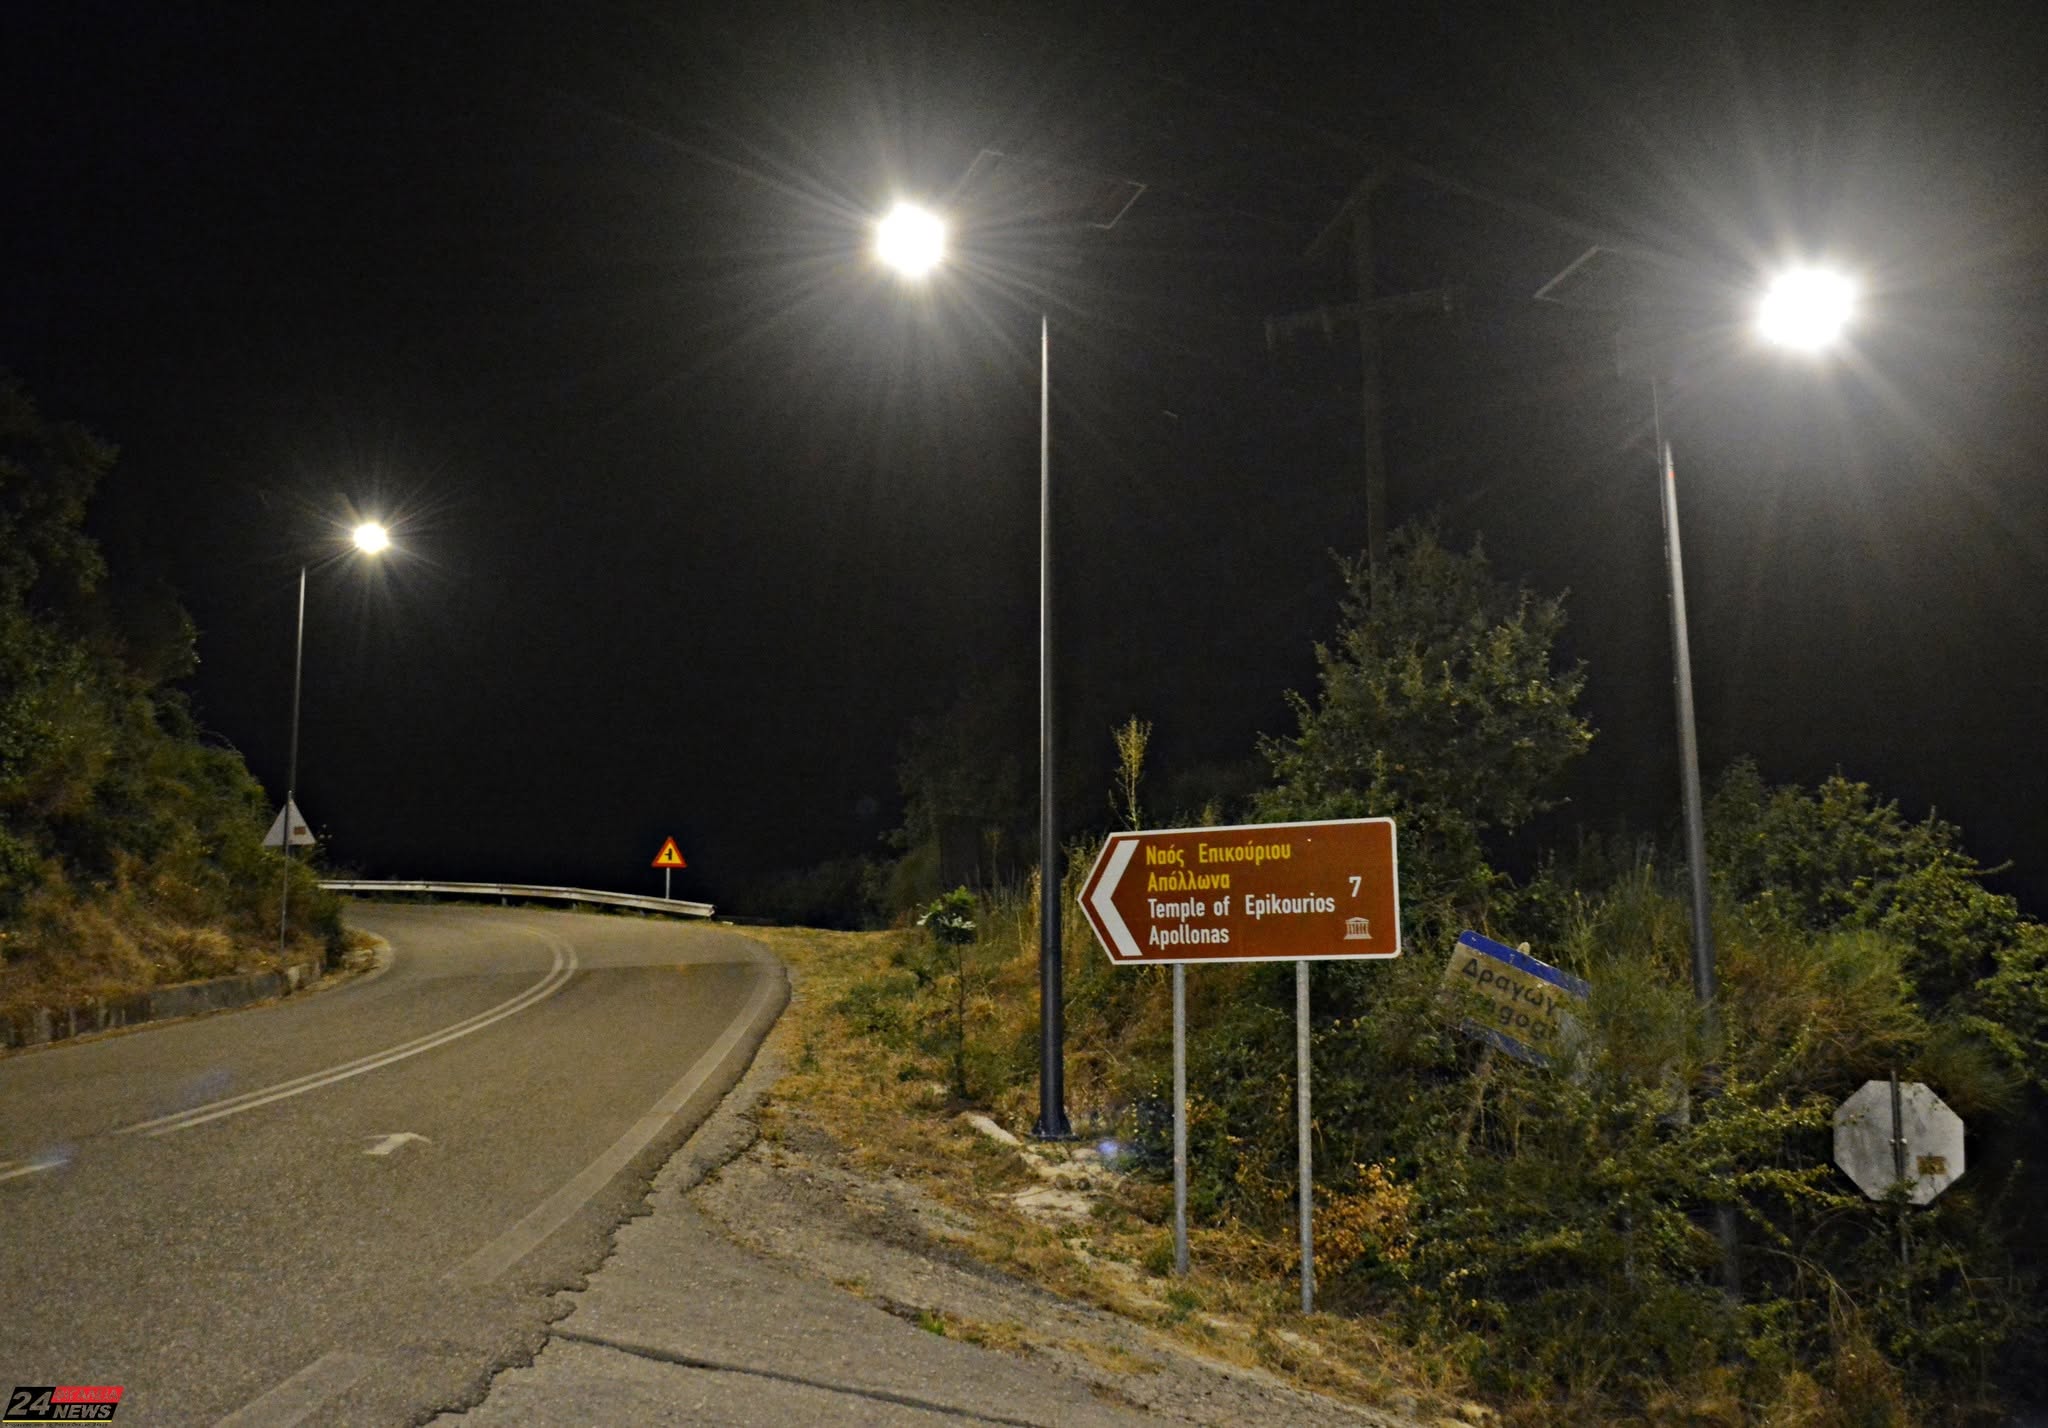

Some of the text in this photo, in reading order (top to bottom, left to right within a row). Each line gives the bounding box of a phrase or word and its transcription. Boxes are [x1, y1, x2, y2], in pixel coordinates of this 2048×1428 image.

[1146, 840, 1291, 867] Ναός Επικούριου
[1147, 870, 1230, 892] Απόλλωνα
[1348, 875, 1362, 898] 7
[1148, 892, 1336, 922] Temple of Epikourios
[1149, 924, 1230, 950] Apollonas
[1462, 958, 1557, 1017] Δραγωγ
